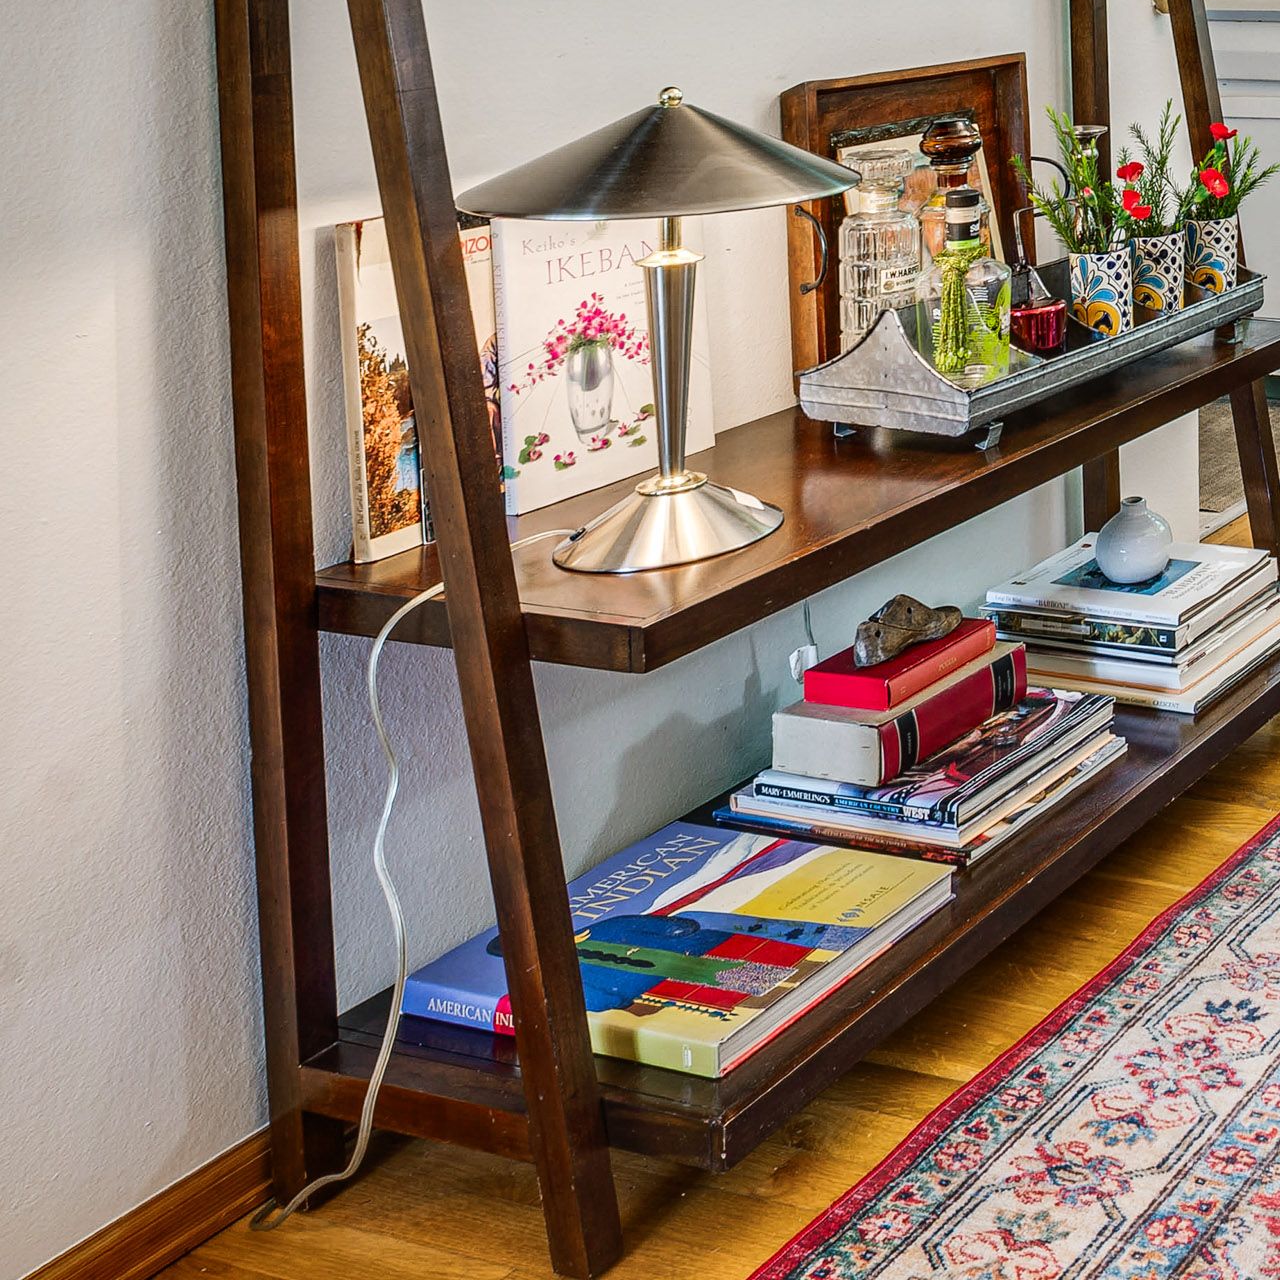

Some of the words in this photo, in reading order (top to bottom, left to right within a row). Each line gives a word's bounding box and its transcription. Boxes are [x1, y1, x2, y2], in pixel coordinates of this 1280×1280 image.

[522, 233, 576, 255] Keiko's
[545, 240, 655, 284] IKEBAN
[493, 264, 504, 317] KEIKO'S
[495, 322, 507, 384] IKEBANA
[834, 797, 864, 810] AMERICAN
[866, 801, 900, 814] COUNTRY
[902, 806, 930, 821] WEST
[573, 836, 721, 920] INDIAN
[428, 998, 492, 1023] AMERICAN
